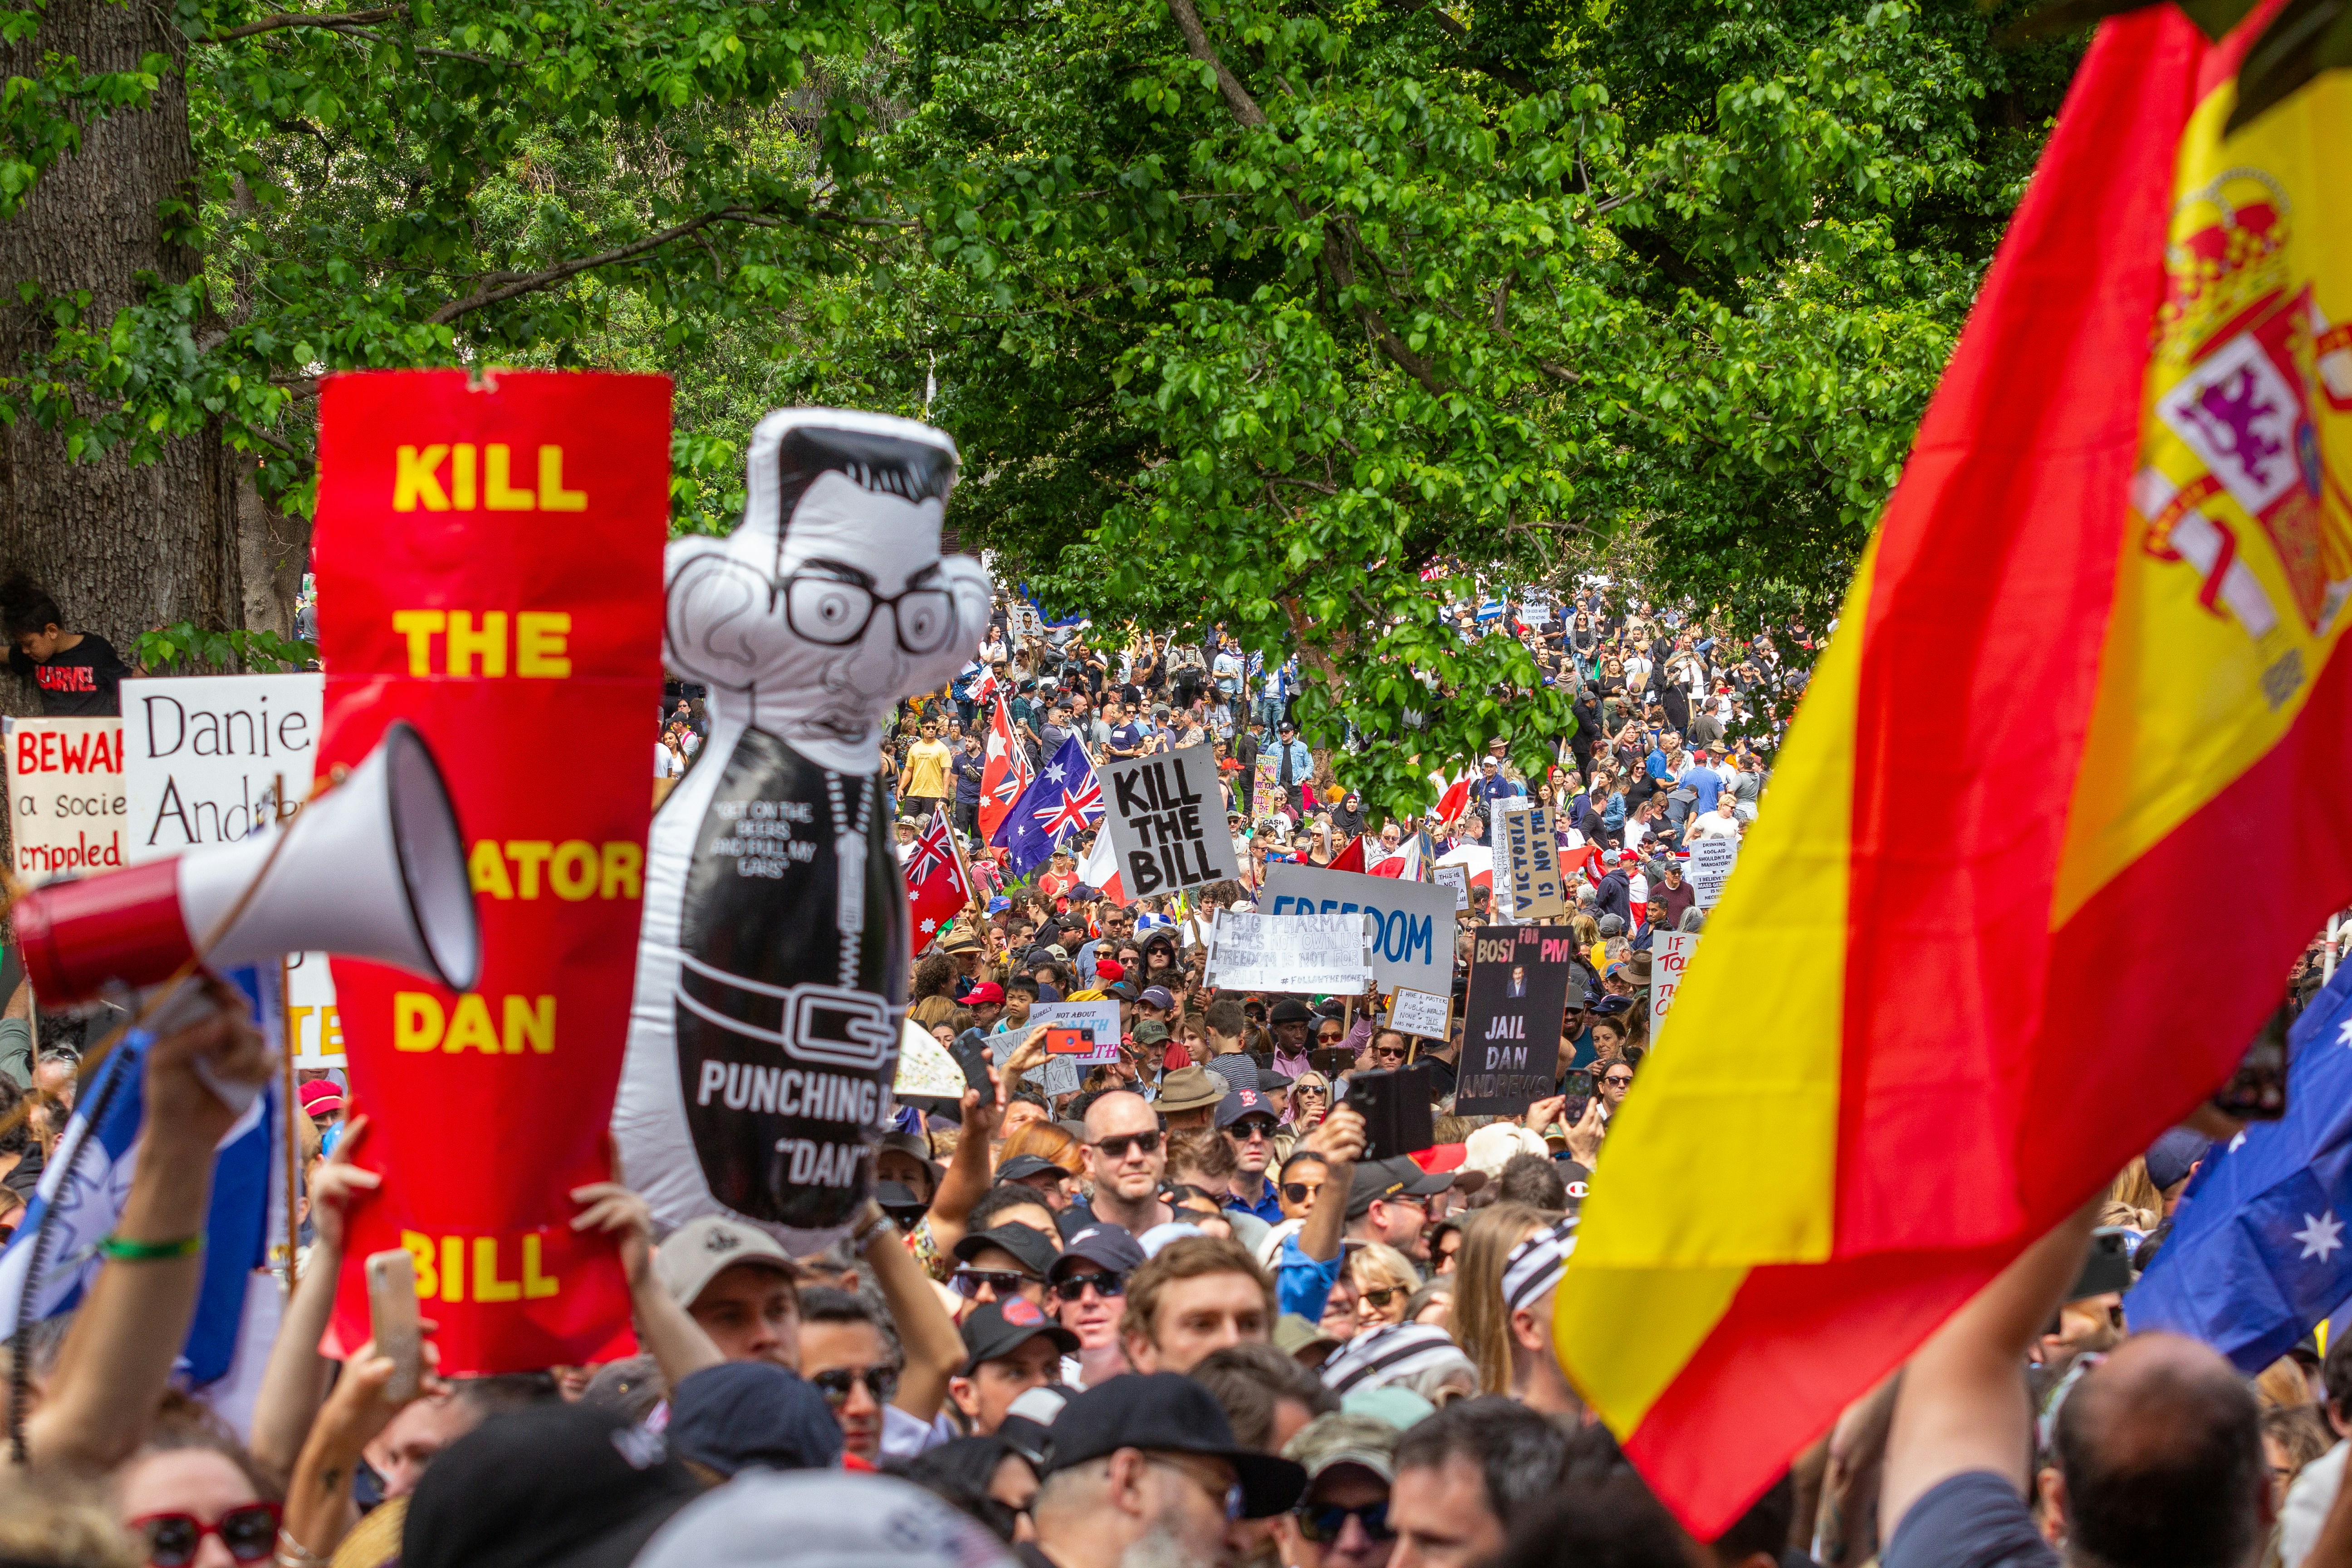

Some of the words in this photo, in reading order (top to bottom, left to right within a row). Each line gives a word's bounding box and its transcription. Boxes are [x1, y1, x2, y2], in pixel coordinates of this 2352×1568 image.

[392, 443, 588, 513] KILL
[391, 609, 572, 679] THE
[142, 695, 311, 758] Danie
[1257, 756, 1277, 765] BOOSTER
[1112, 758, 1202, 818] KILL
[1253, 796, 1265, 805] GOOD
[19, 795, 38, 816] a
[56, 794, 127, 818] socie
[779, 801, 814, 823] THE
[1259, 805, 1269, 813] BYE
[1129, 805, 1203, 848] THE
[1530, 809, 1546, 835] THE
[20, 830, 123, 877] crippled
[1509, 815, 1533, 911] VICTORIA
[1532, 840, 1552, 872] NOT
[470, 839, 643, 901] ATOR
[1128, 840, 1222, 896] BILL
[1538, 882, 1554, 897] IS
[1232, 913, 1261, 933] BIG
[1272, 913, 1348, 934] PHARMA
[1231, 931, 1264, 950] DOES
[1270, 933, 1297, 951] NOT
[1302, 933, 1337, 950] OWN
[1476, 938, 1516, 963] BOSI
[1519, 928, 1539, 945] FOR
[1540, 939, 1569, 963] PM
[1668, 936, 1686, 951] IF
[1216, 948, 1277, 968] FREEDOM
[1282, 952, 1294, 967] IS
[1299, 952, 1327, 967] NOT
[1333, 950, 1359, 967] FOR
[1281, 974, 1367, 985] #FOLLOWTHEMONEY
[1032, 1005, 1053, 1019] SURELY
[1404, 1002, 1424, 1012] PUBLIC
[1426, 1008, 1446, 1016] HEALTH
[1426, 996, 1447, 1004] MASTERS
[289, 1005, 347, 1056] TE
[393, 991, 556, 1054] DAN
[1067, 1019, 1110, 1032] ALTH
[1485, 1015, 1525, 1040] JAIL
[1485, 1046, 1528, 1070] DAN
[697, 1058, 878, 1125] PUNCHING
[1460, 1074, 1550, 1099] ANDREWS
[401, 1229, 559, 1303] BILL
